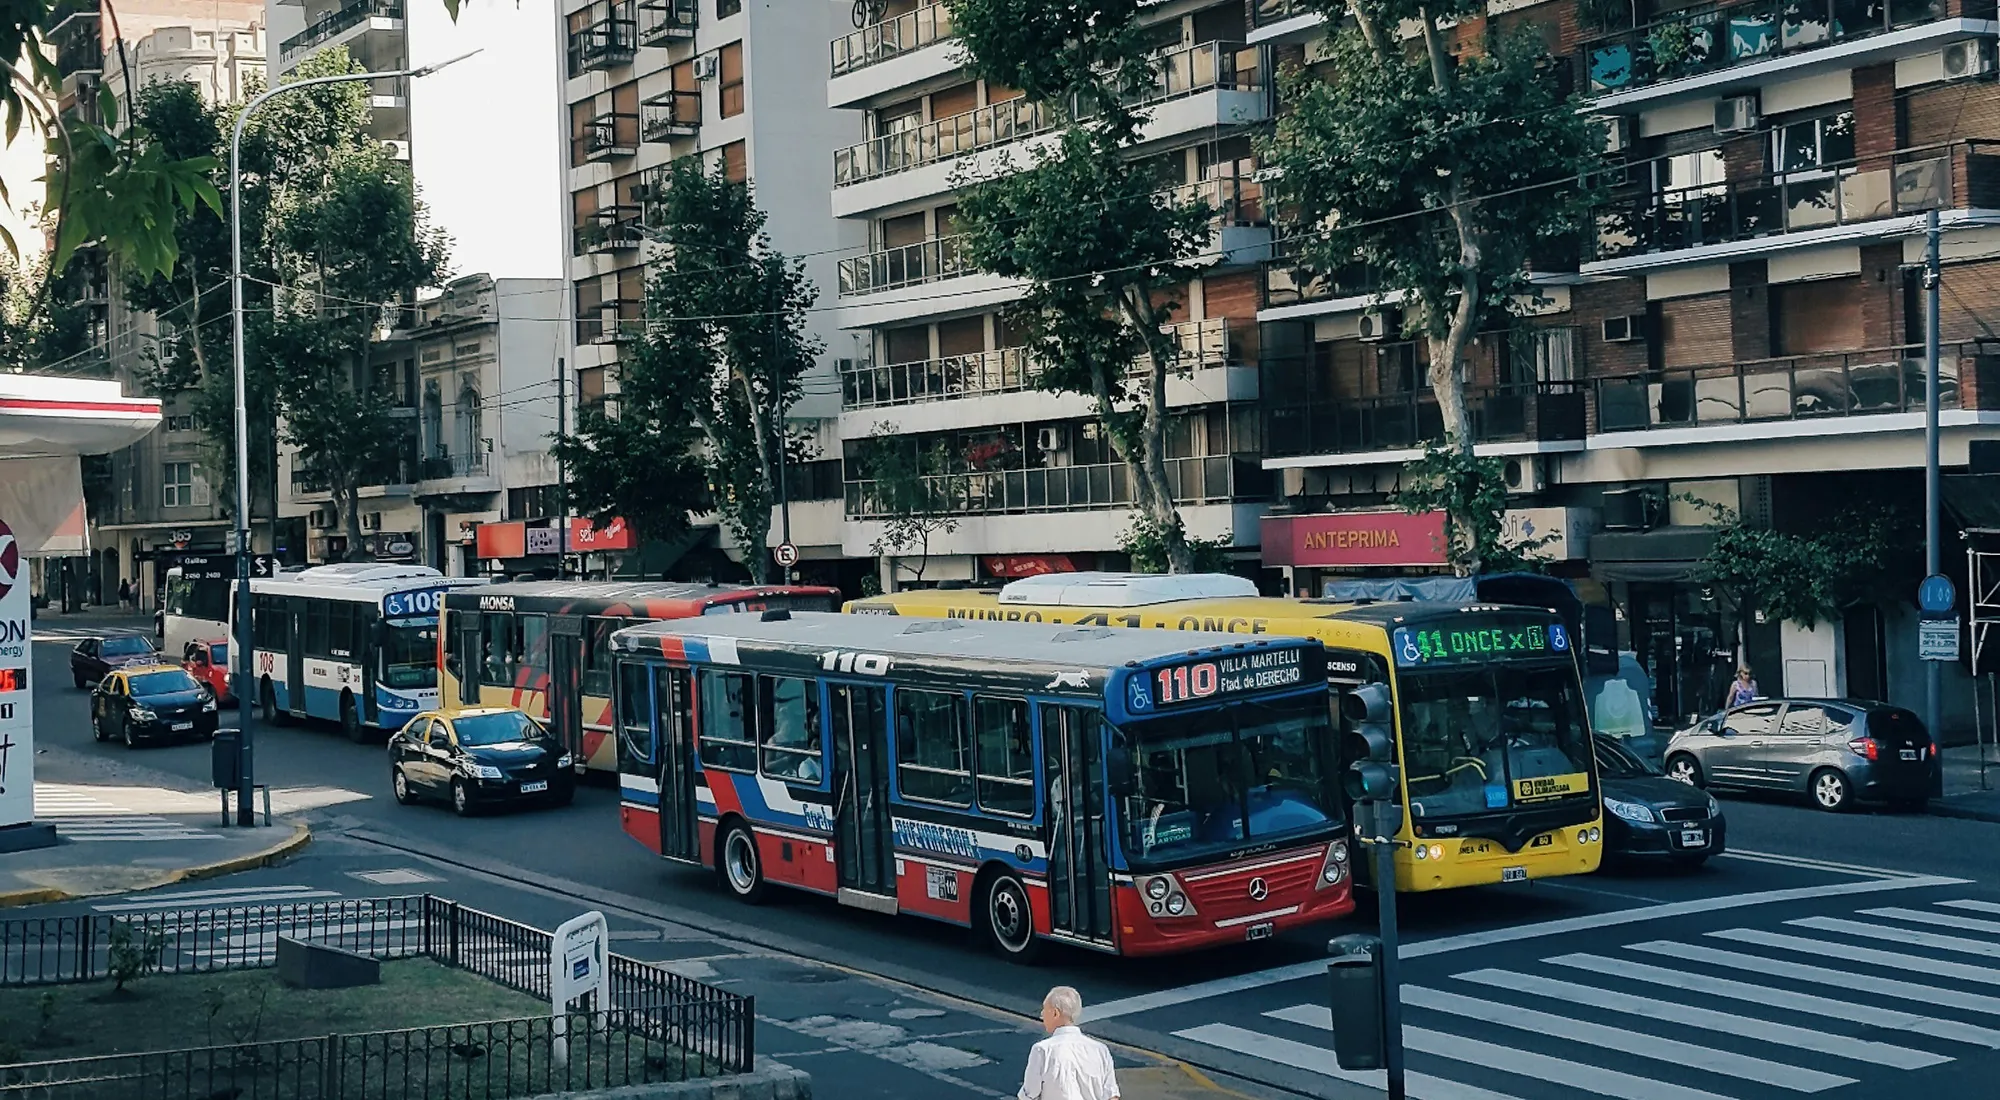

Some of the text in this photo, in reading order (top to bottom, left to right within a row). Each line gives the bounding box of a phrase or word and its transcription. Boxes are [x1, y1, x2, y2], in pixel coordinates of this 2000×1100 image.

[168, 530, 192, 543] 365
[1304, 529, 1400, 549] ANTEPRIMA
[403, 591, 442, 614] 108
[479, 596, 515, 611] MONSA
[1178, 616, 1268, 635] ONCE
[0, 645, 24, 657] nergy
[1451, 629, 1505, 653] ONCE
[259, 652, 275, 672] 108
[822, 649, 890, 676] 110
[1327, 661, 1357, 672] SCENSO
[1158, 649, 1300, 702] 110 VILLA MARTELLI
[1243, 672, 1255, 689] de
[1256, 667, 1300, 687] DERECHO
[1478, 843, 1490, 853] 41
